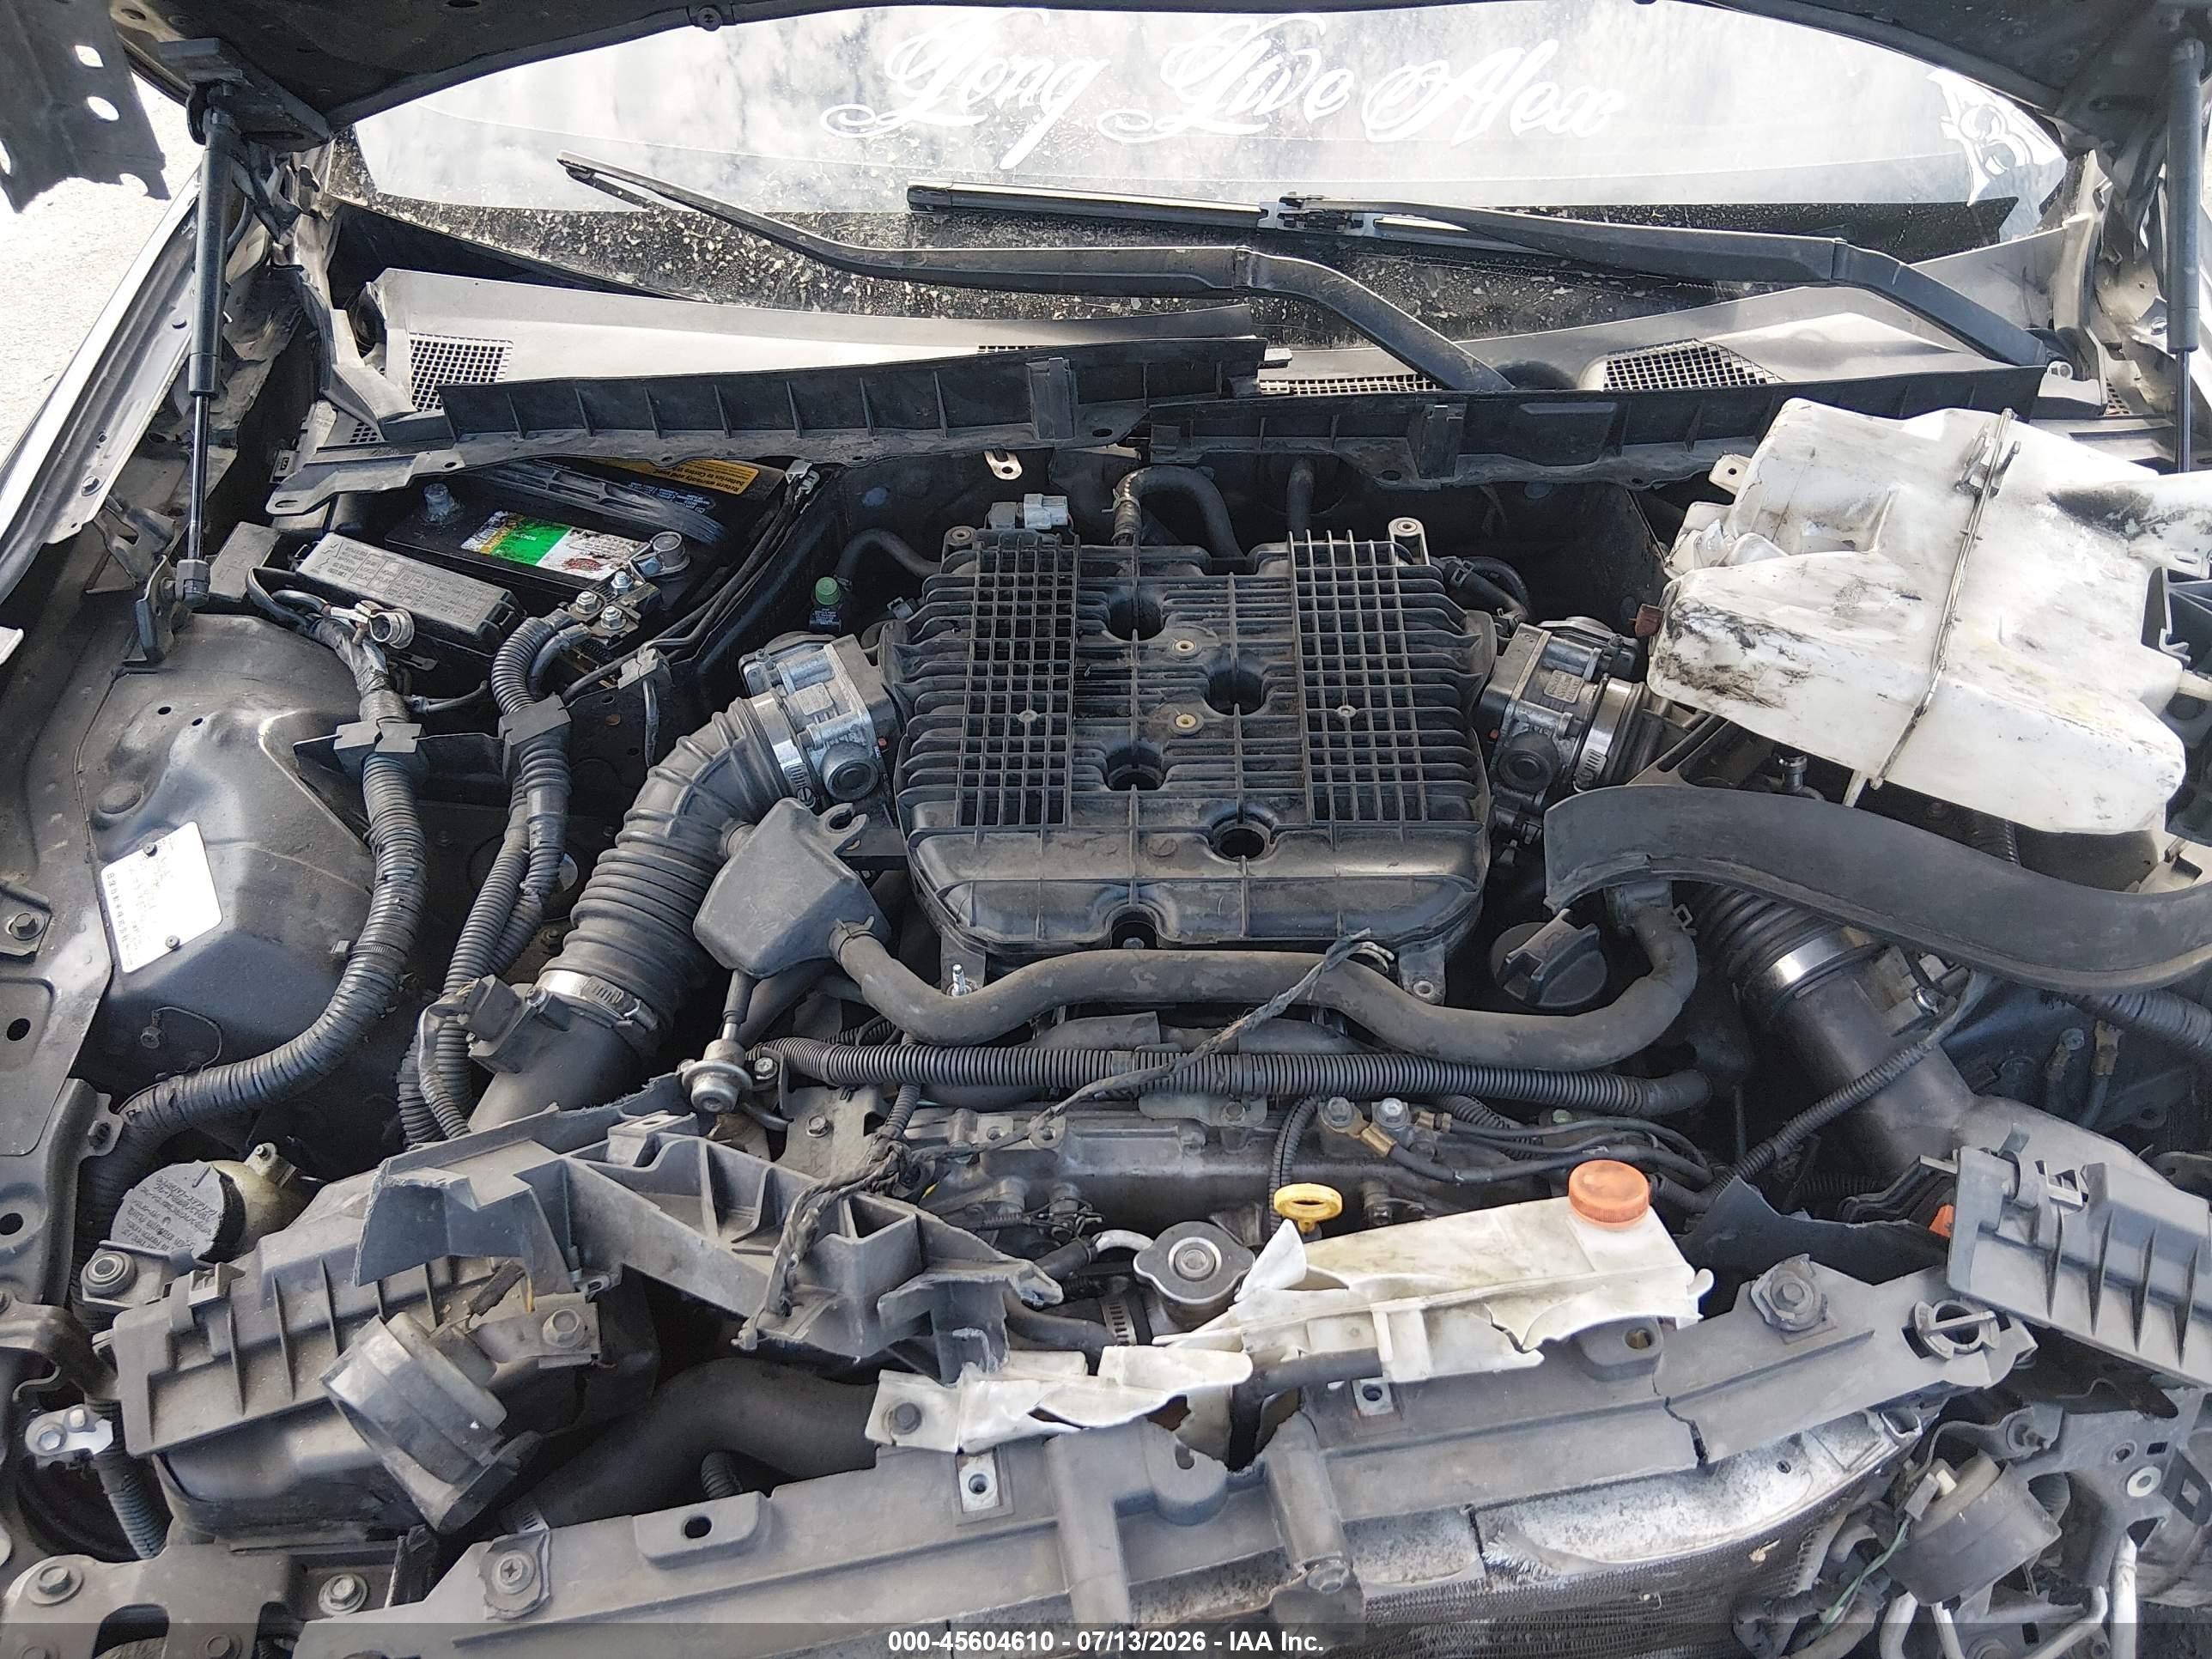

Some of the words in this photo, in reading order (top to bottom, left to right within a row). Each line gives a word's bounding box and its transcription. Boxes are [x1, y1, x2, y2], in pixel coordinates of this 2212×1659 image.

[819, 9, 1110, 170] Long
[1097, 12, 1355, 143] Live
[1360, 39, 1626, 149] Alex
